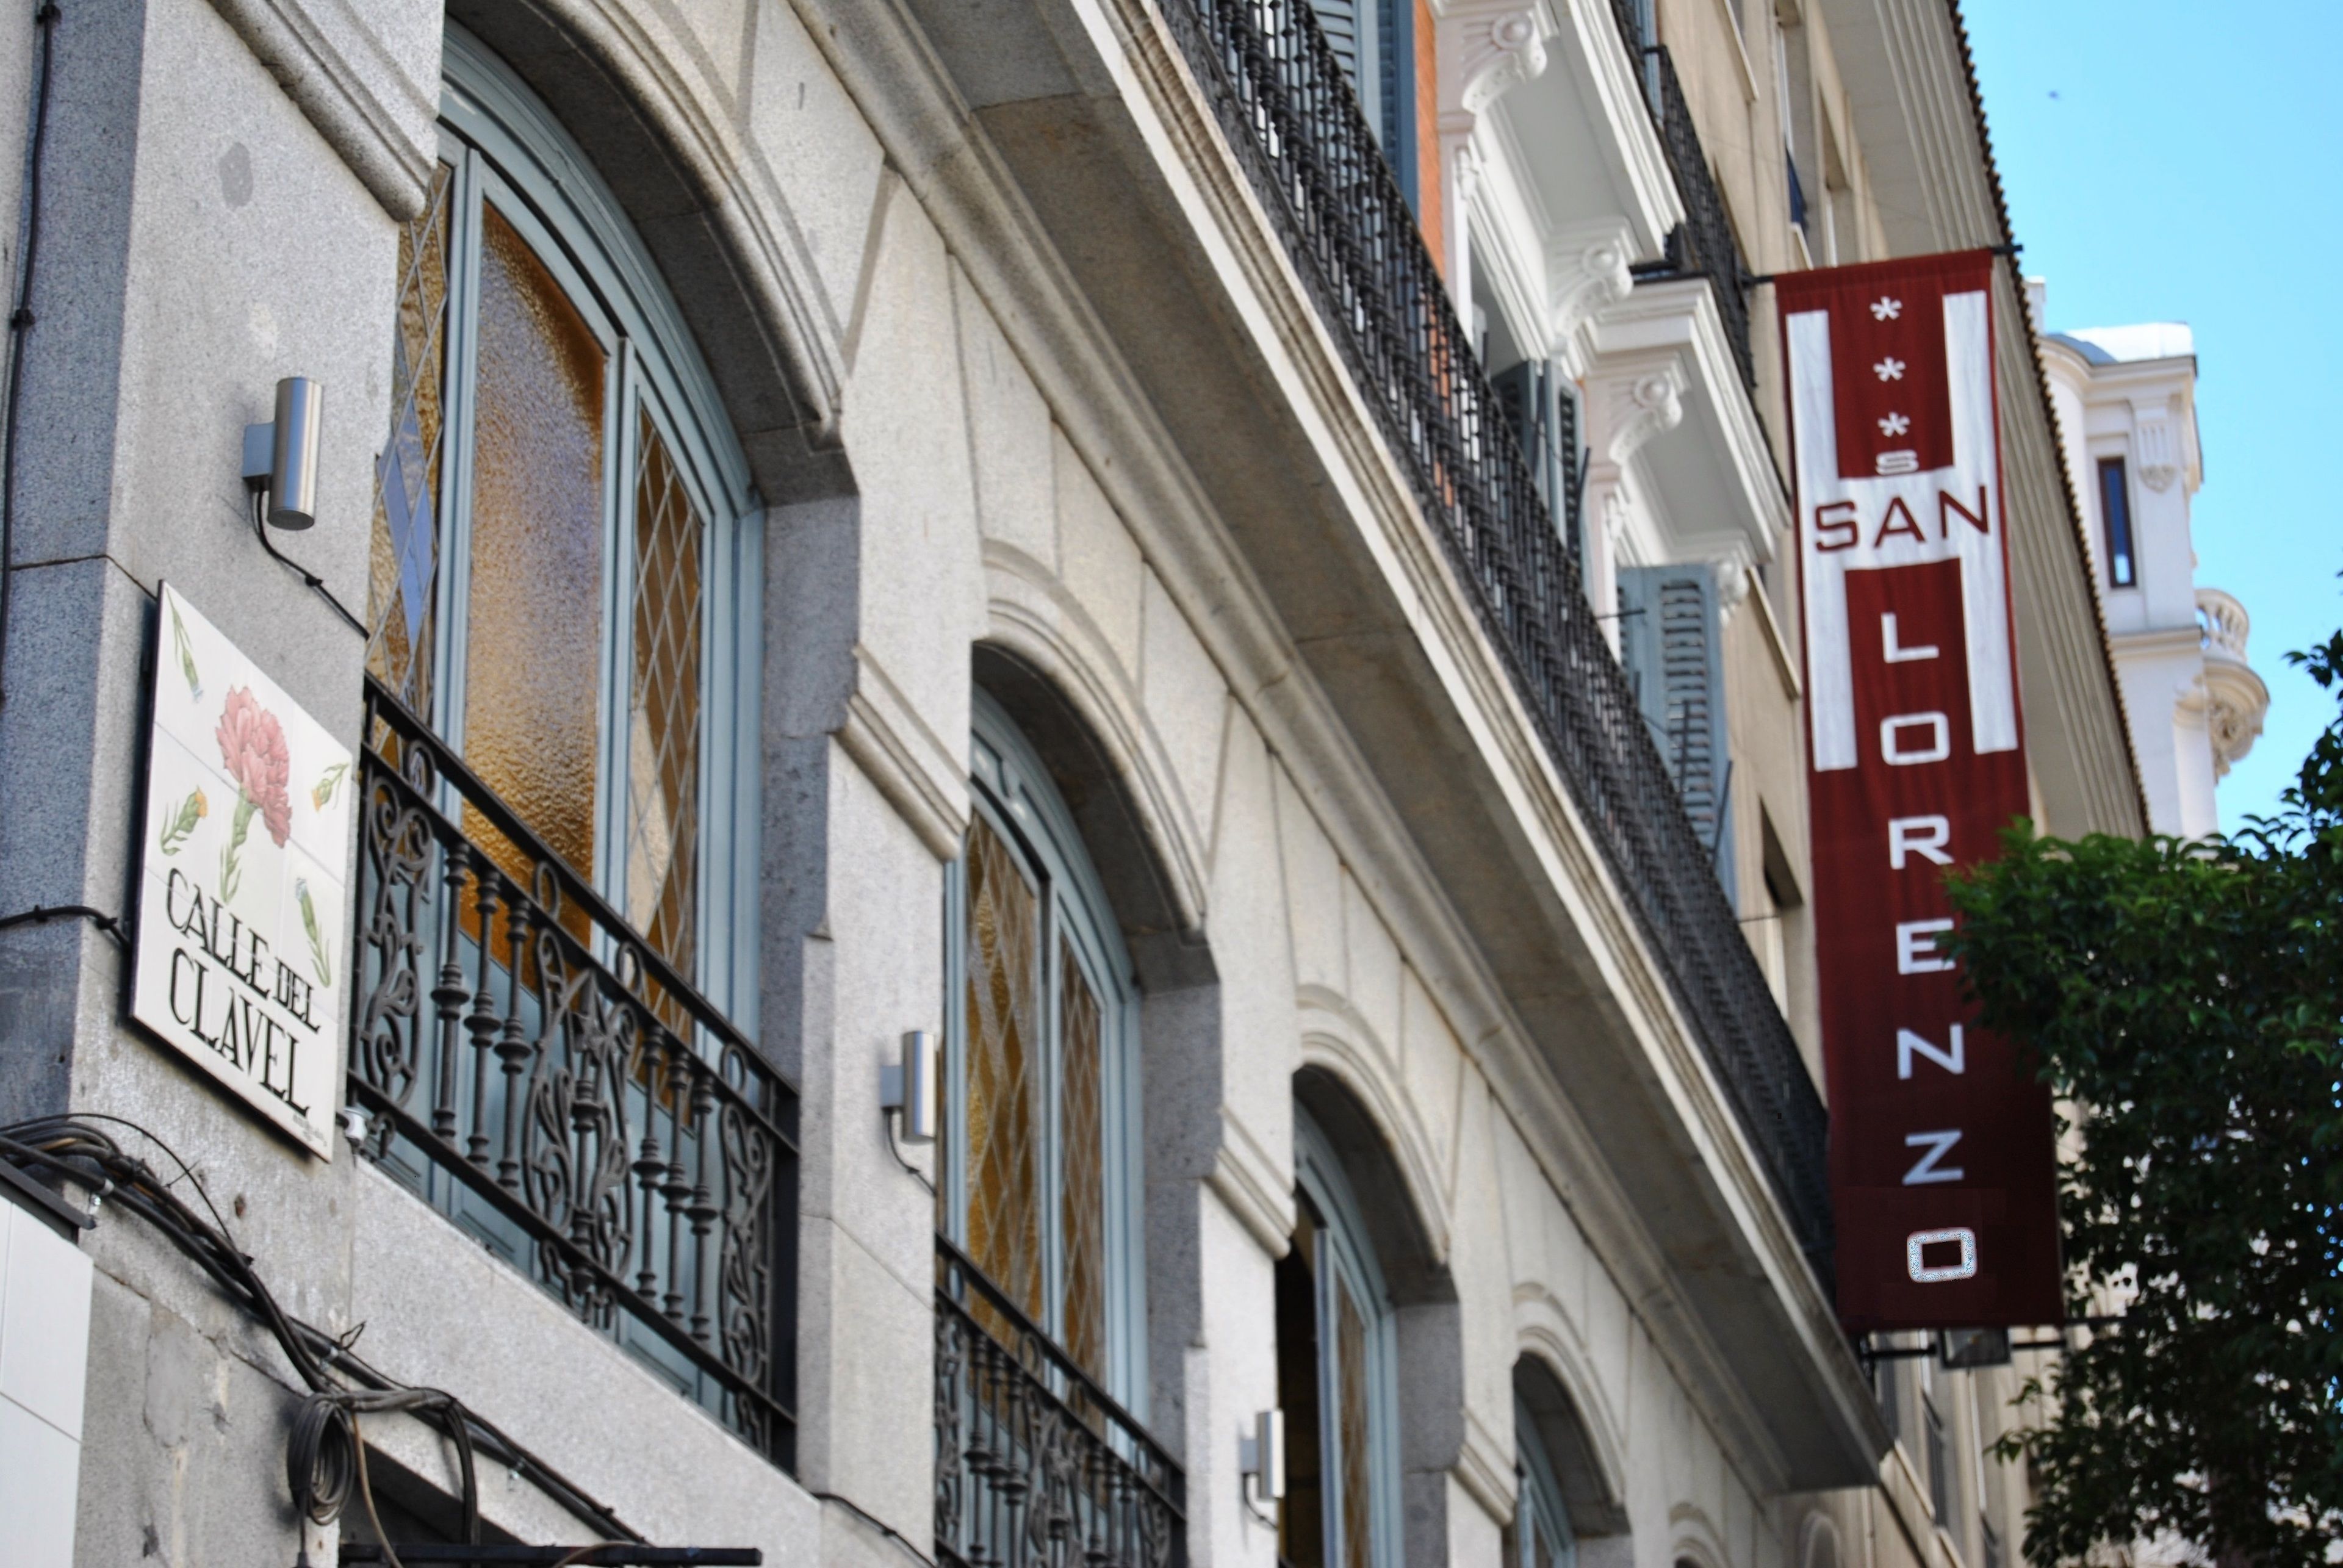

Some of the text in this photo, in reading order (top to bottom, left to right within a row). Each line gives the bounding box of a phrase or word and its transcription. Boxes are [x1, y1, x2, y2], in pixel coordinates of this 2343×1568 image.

[1814, 484, 1990, 553] SAN
[166, 867, 321, 1035] CALLE DEL
[1879, 611, 1978, 1283] LORENZO
[169, 947, 311, 1118] CLAVEL
